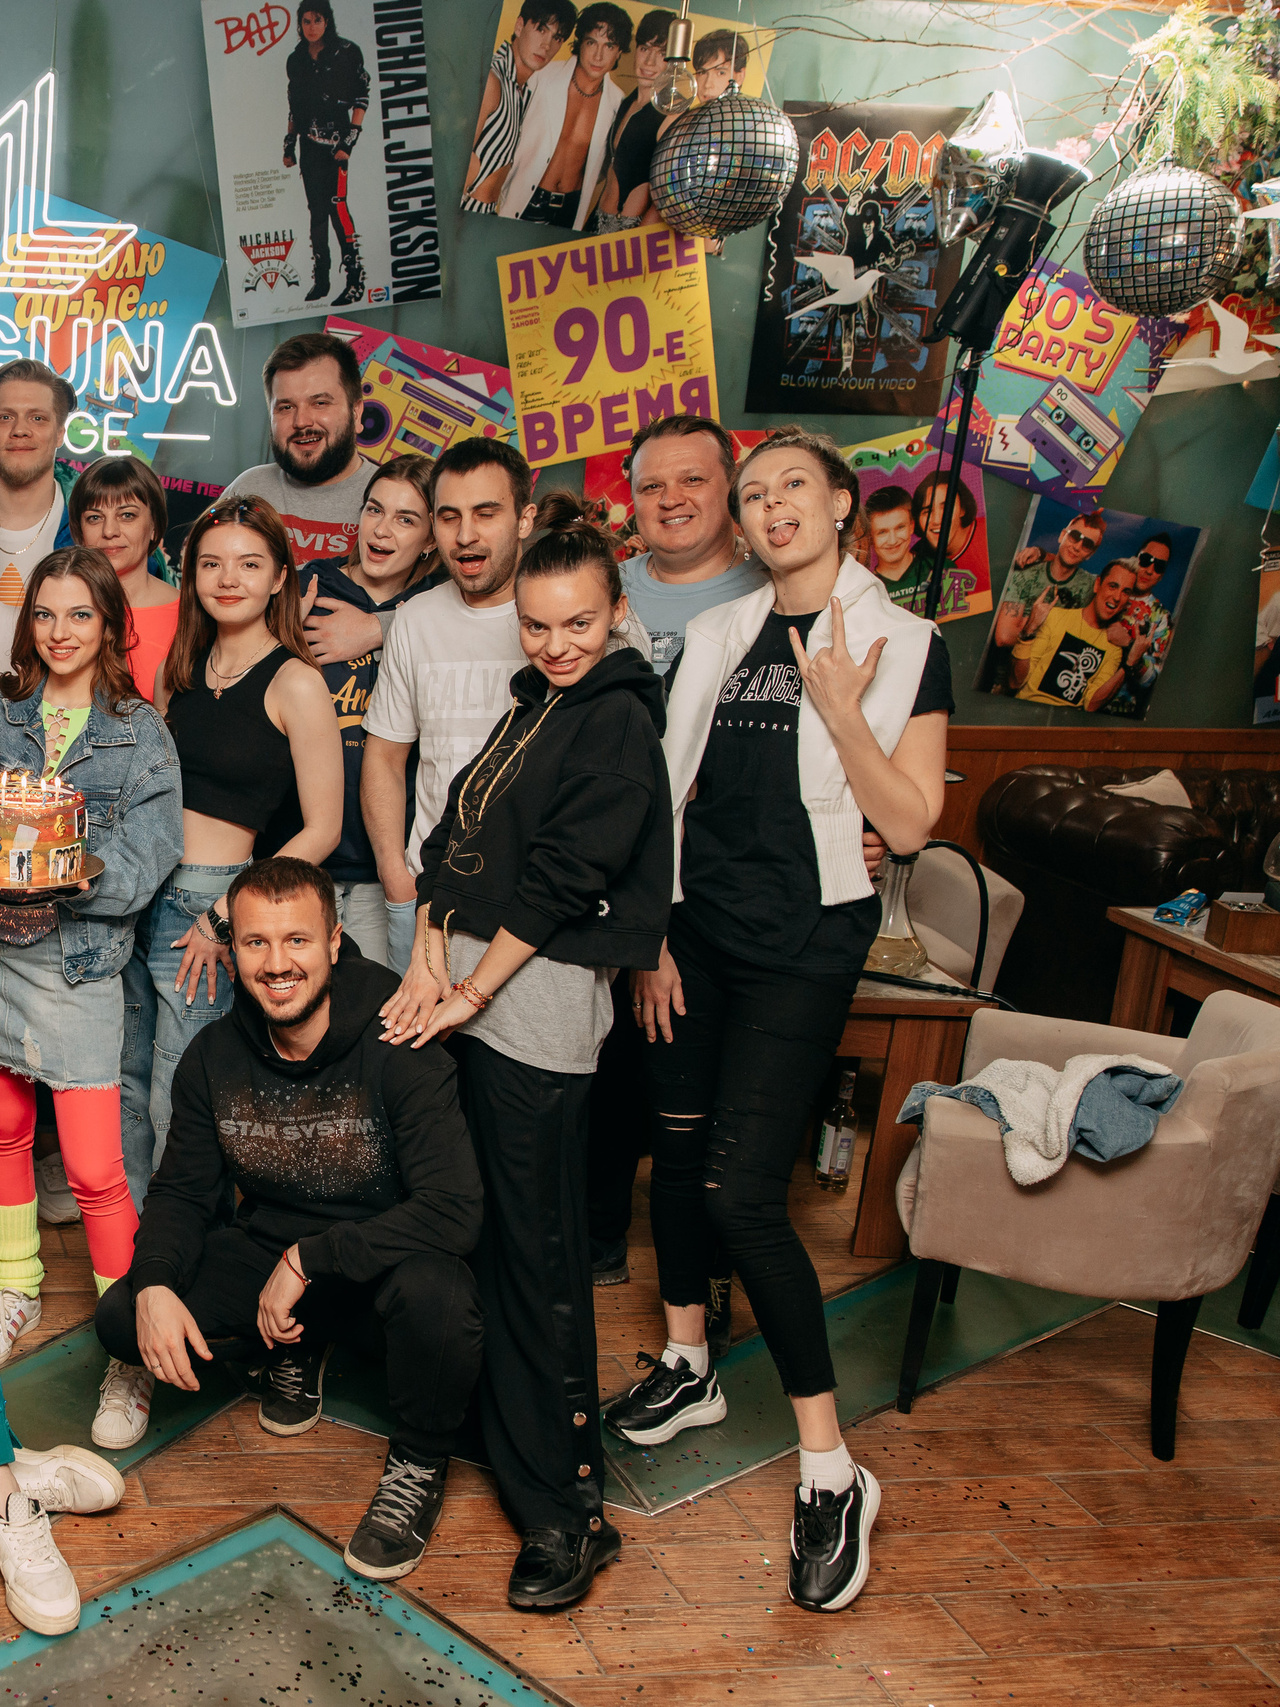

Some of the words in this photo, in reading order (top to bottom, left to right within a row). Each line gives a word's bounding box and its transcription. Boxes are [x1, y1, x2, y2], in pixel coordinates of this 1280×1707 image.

[215, 2, 291, 56] BAD
[383, 140, 442, 304] JACKSON
[239, 229, 295, 247] MICHAEL
[250, 245, 286, 260] JACKSON
[508, 230, 699, 303] ЛУЧШЕЕ
[371, 291, 386, 299] PEPSI
[1018, 277, 1121, 344] 90'S
[511, 318, 541, 329] ЗАНОВО!
[554, 296, 686, 386] 90-Е
[998, 322, 1107, 378] PARTY
[780, 373, 818, 387] BLOW
[821, 376, 838, 389] UP
[841, 376, 875, 390] YOUR
[879, 378, 917, 390] VIDEO
[1056, 388, 1068, 401] 90
[523, 375, 711, 463] ВРЕМЯ
[347, 653, 372, 670] SUP
[422, 667, 510, 713] CALVI
[740, 664, 801, 708] ANGE
[716, 719, 791, 732] ALIFORN
[345, 740, 359, 748] ESTD
[220, 1119, 277, 1140] STAR
[282, 1118, 376, 1141] SYSTEM
